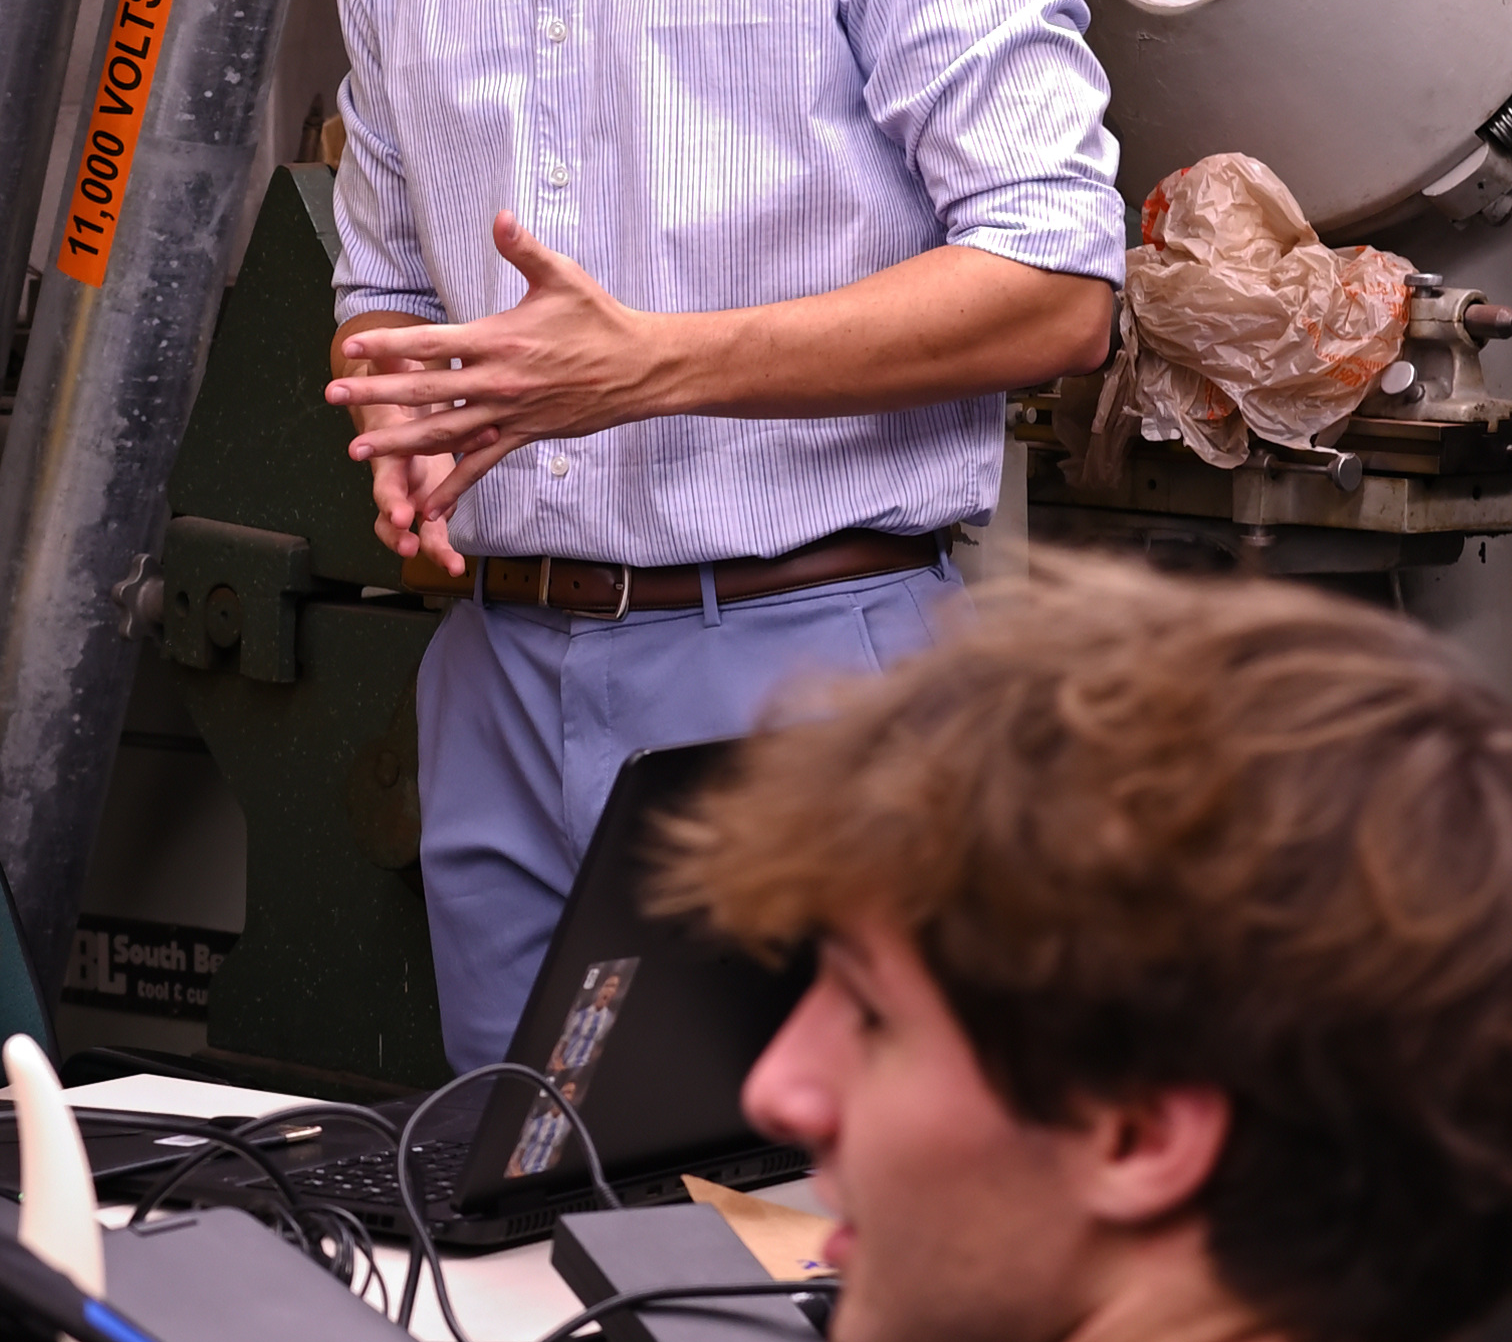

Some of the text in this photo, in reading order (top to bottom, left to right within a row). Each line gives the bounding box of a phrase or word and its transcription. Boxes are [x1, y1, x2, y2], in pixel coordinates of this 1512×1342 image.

[67, 130, 125, 256] 11,000
[113, 934, 225, 974] South Be
[137, 980, 169, 1001] tool
